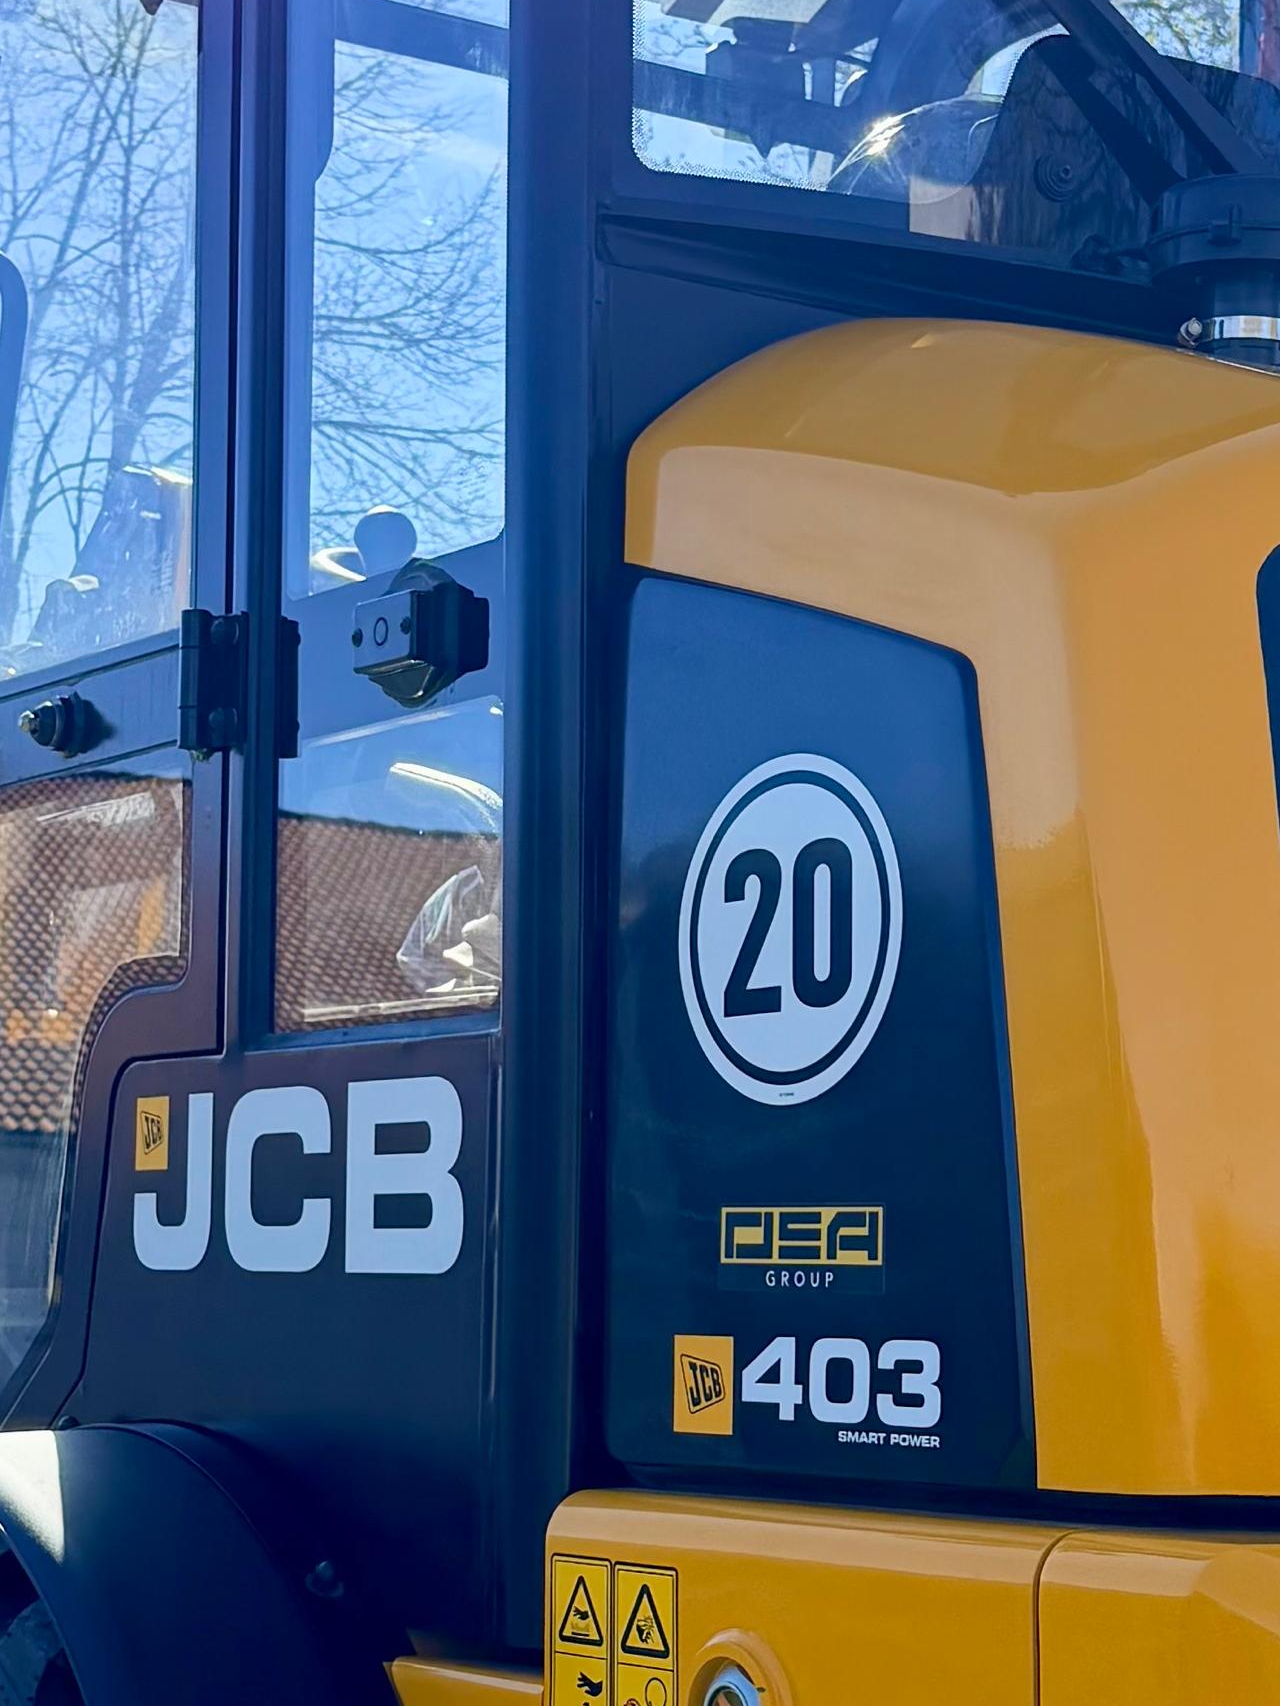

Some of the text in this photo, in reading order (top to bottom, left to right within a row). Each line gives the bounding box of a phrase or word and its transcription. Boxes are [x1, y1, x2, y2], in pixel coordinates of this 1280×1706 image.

[724, 837, 853, 1018] 20
[133, 1075, 465, 1275] JCB
[764, 1269, 835, 1288] GROUP
[688, 1360, 722, 1408] JCB
[741, 1336, 942, 1429] 403
[837, 1430, 940, 1449] SMART POWER
